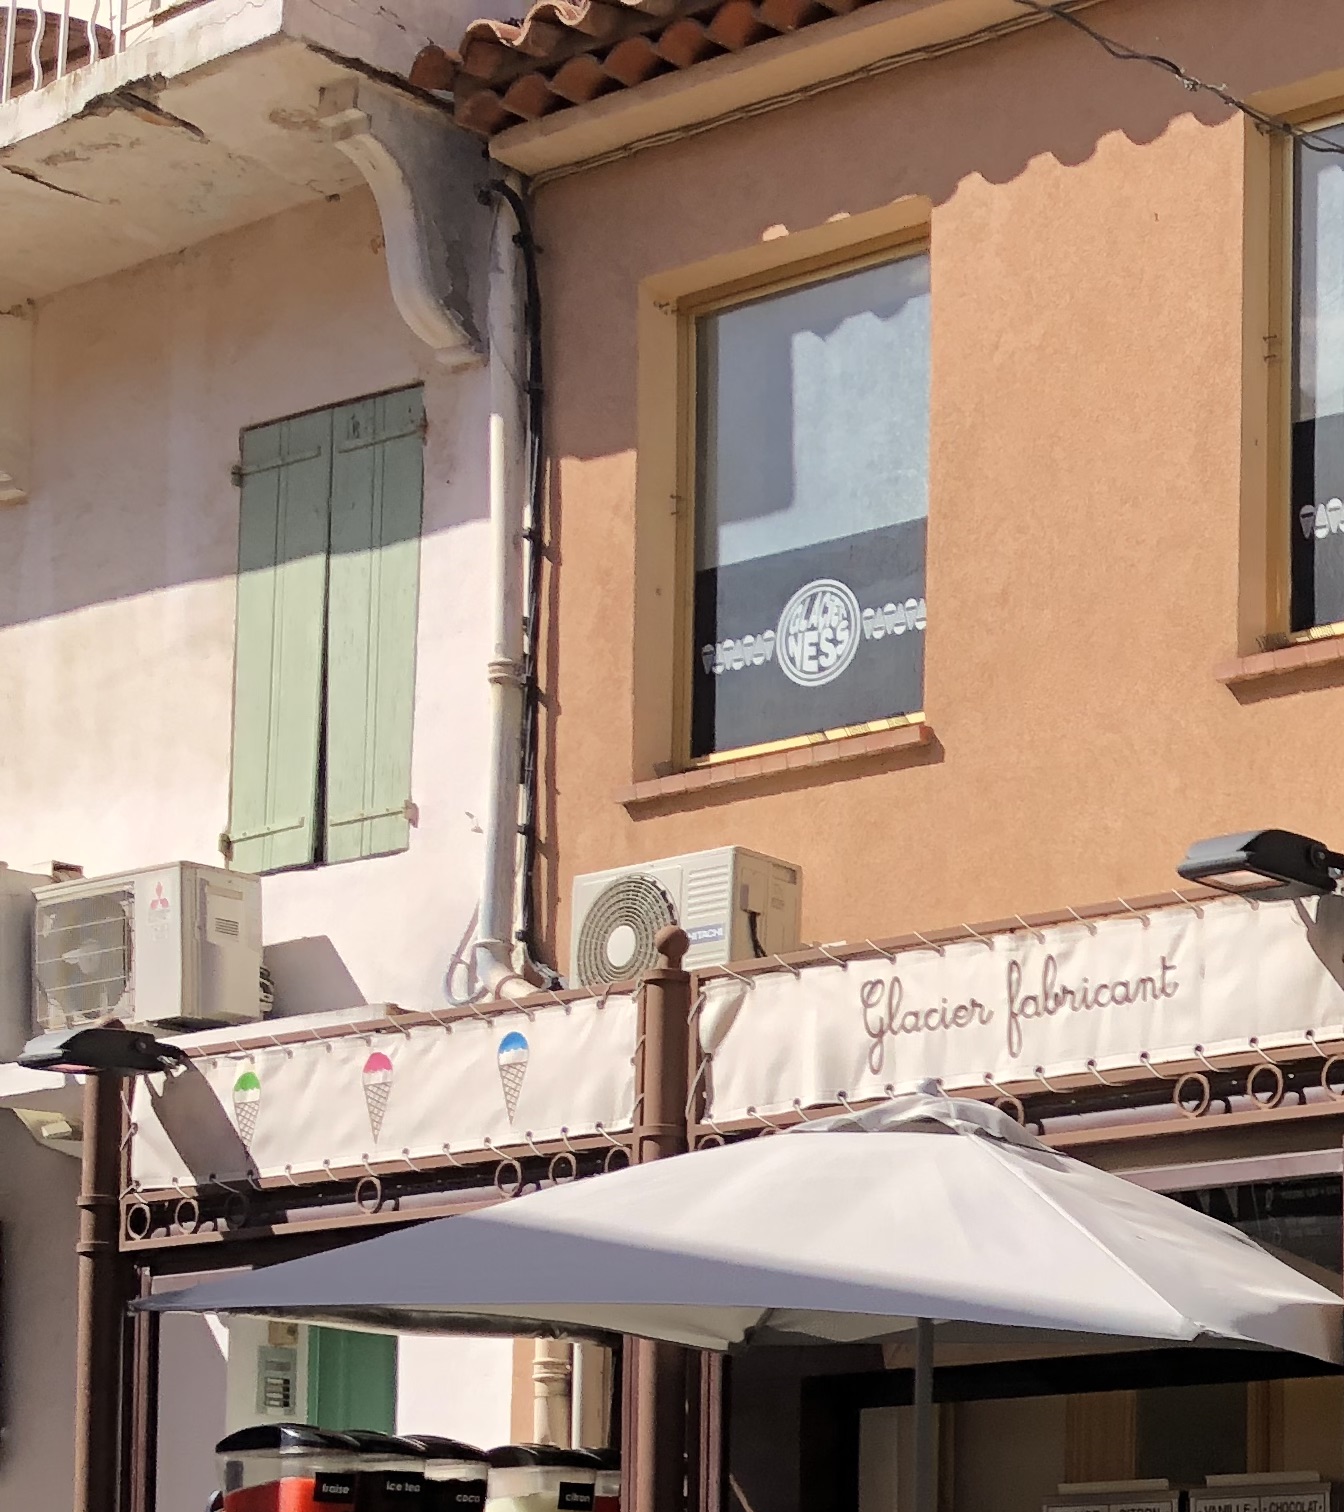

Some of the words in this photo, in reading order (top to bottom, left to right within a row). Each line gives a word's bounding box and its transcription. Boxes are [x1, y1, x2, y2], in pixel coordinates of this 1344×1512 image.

[788, 621, 850, 672] NESS
[860, 975, 994, 1074] Glacier
[1006, 954, 1180, 1058] fabricant
[321, 1482, 351, 1495] fraise
[564, 1491, 591, 1503] citron
